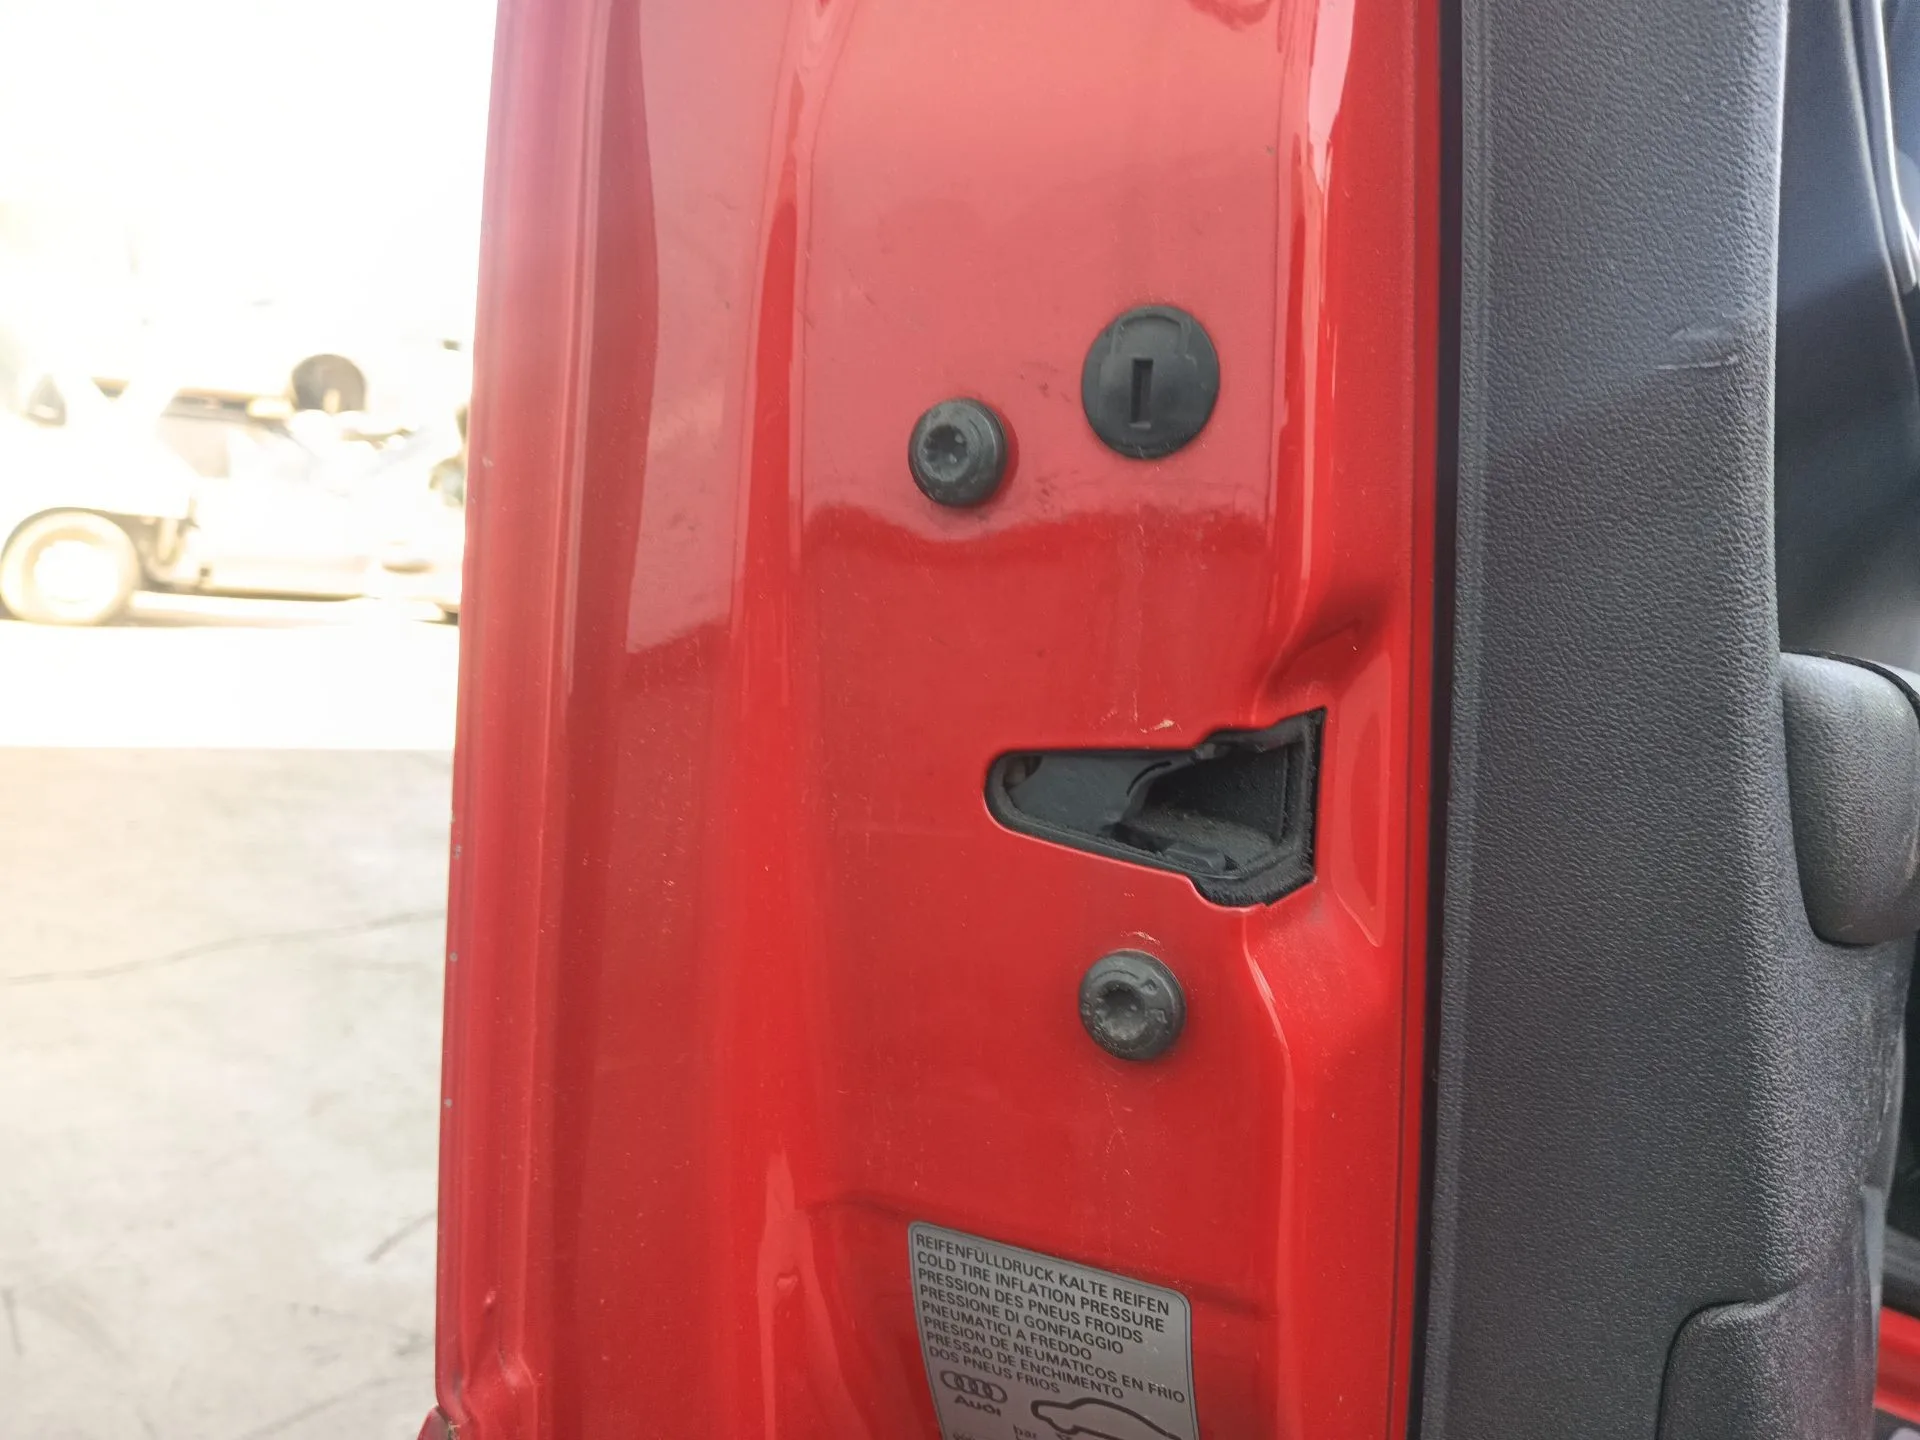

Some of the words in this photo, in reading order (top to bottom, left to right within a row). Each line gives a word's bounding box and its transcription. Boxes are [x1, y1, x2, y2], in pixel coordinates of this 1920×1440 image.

[918, 1251, 955, 1270] COLD
[960, 1262, 991, 1283] TIRE
[996, 1272, 1075, 1307] INFLATION
[1081, 1297, 1164, 1332] PRESSURE
[919, 1268, 990, 1299] PRESSION
[995, 1289, 1023, 1308] DES
[1028, 1299, 1080, 1325] PNEUS
[1085, 1316, 1143, 1343] FROIDS
[920, 1284, 1000, 1318] PRESSIONE
[1005, 1309, 1019, 1323] DI
[1024, 1315, 1123, 1354] GONFIAGGIO
[1059, 1272, 1107, 1299] KALTE
[1113, 1288, 1169, 1315] REIFEN
[922, 1300, 1011, 1336] PNEUMATICI
[1016, 1329, 1026, 1341] A
[1030, 1332, 1092, 1360] FREDDO
[924, 1316, 985, 1343] PRESION
[990, 1335, 1009, 1350] DE
[1014, 1342, 1116, 1383] NEUMATICOS
[1122, 1374, 1143, 1391] EN
[1148, 1382, 1185, 1403] FRIO
[926, 1331, 993, 1360] PRESSAO
[997, 1350, 1016, 1366] DE
[1021, 1359, 1123, 1399] ENCHIMENTO
[929, 1346, 959, 1363] DOS
[964, 1355, 1012, 1380] PNEUS
[1017, 1371, 1060, 1394] FRIOS
